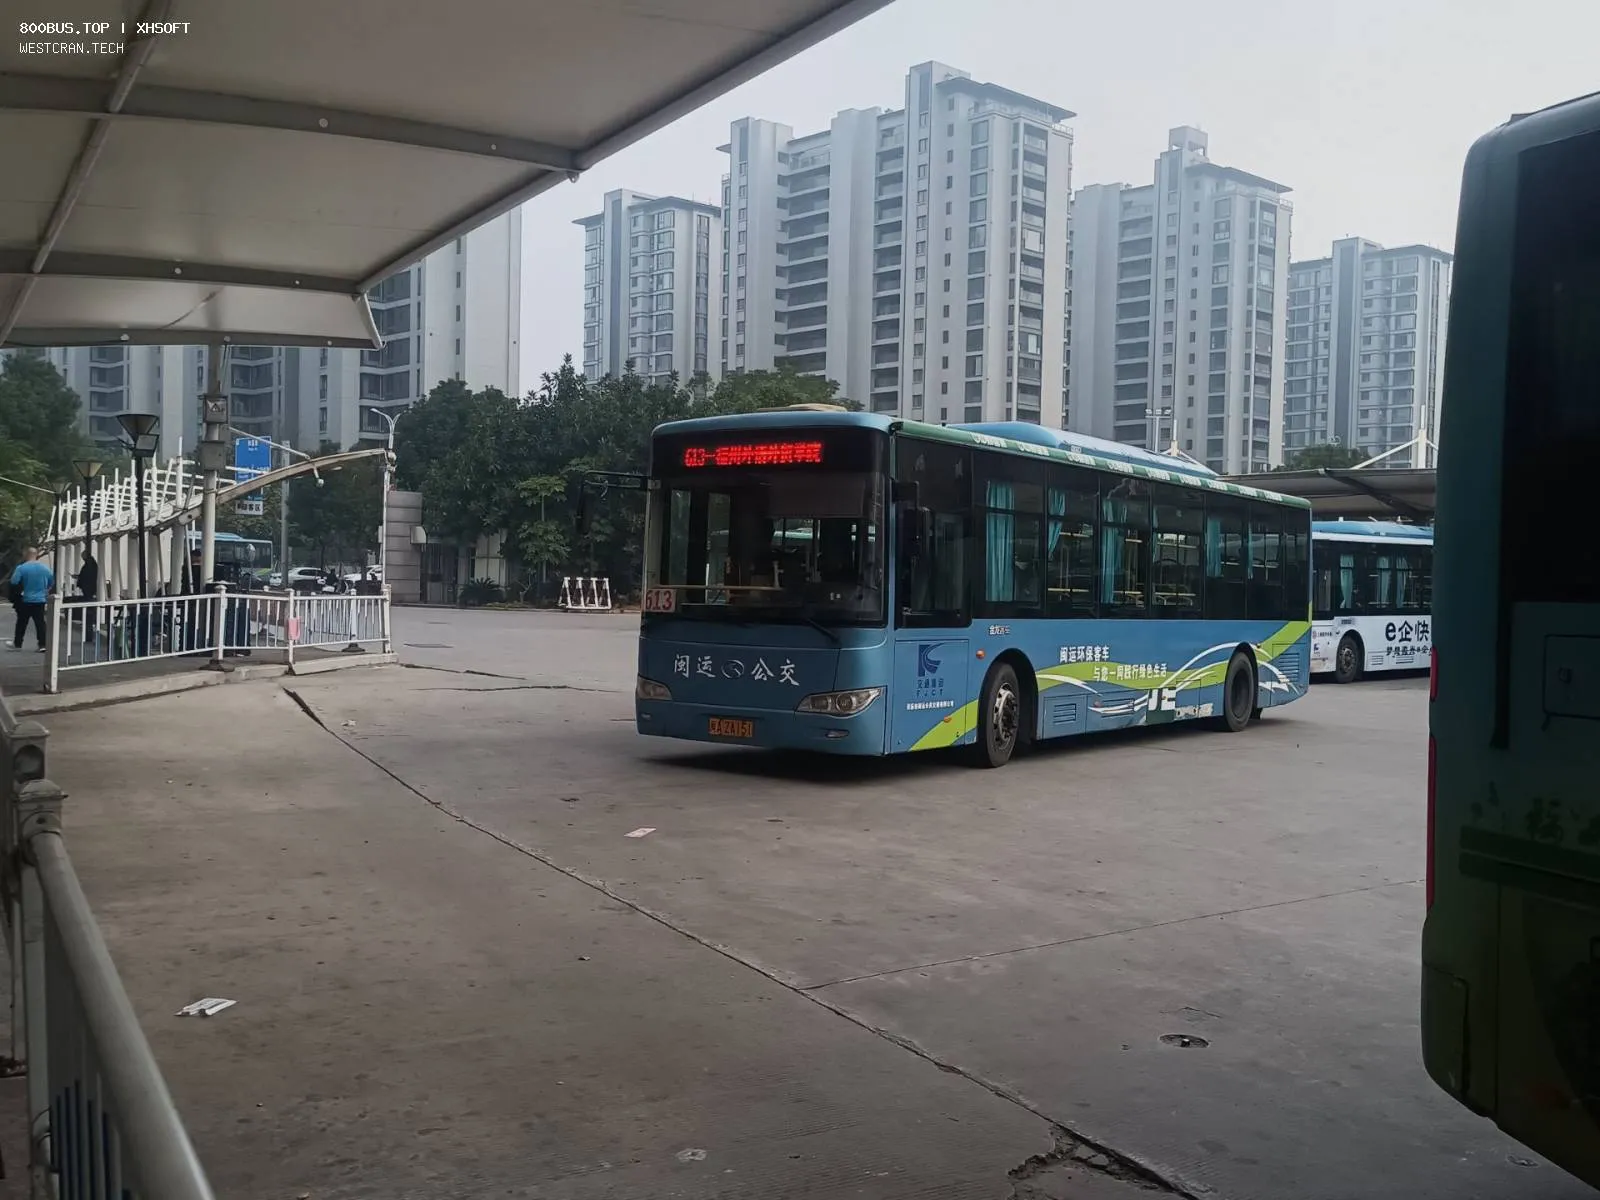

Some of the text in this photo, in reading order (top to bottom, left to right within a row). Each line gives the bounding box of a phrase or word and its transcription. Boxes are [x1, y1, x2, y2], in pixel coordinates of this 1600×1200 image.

[645, 590, 672, 610] 613
[1059, 645, 1110, 663] 闽运环保客车
[674, 653, 801, 687] 闽运 公交
